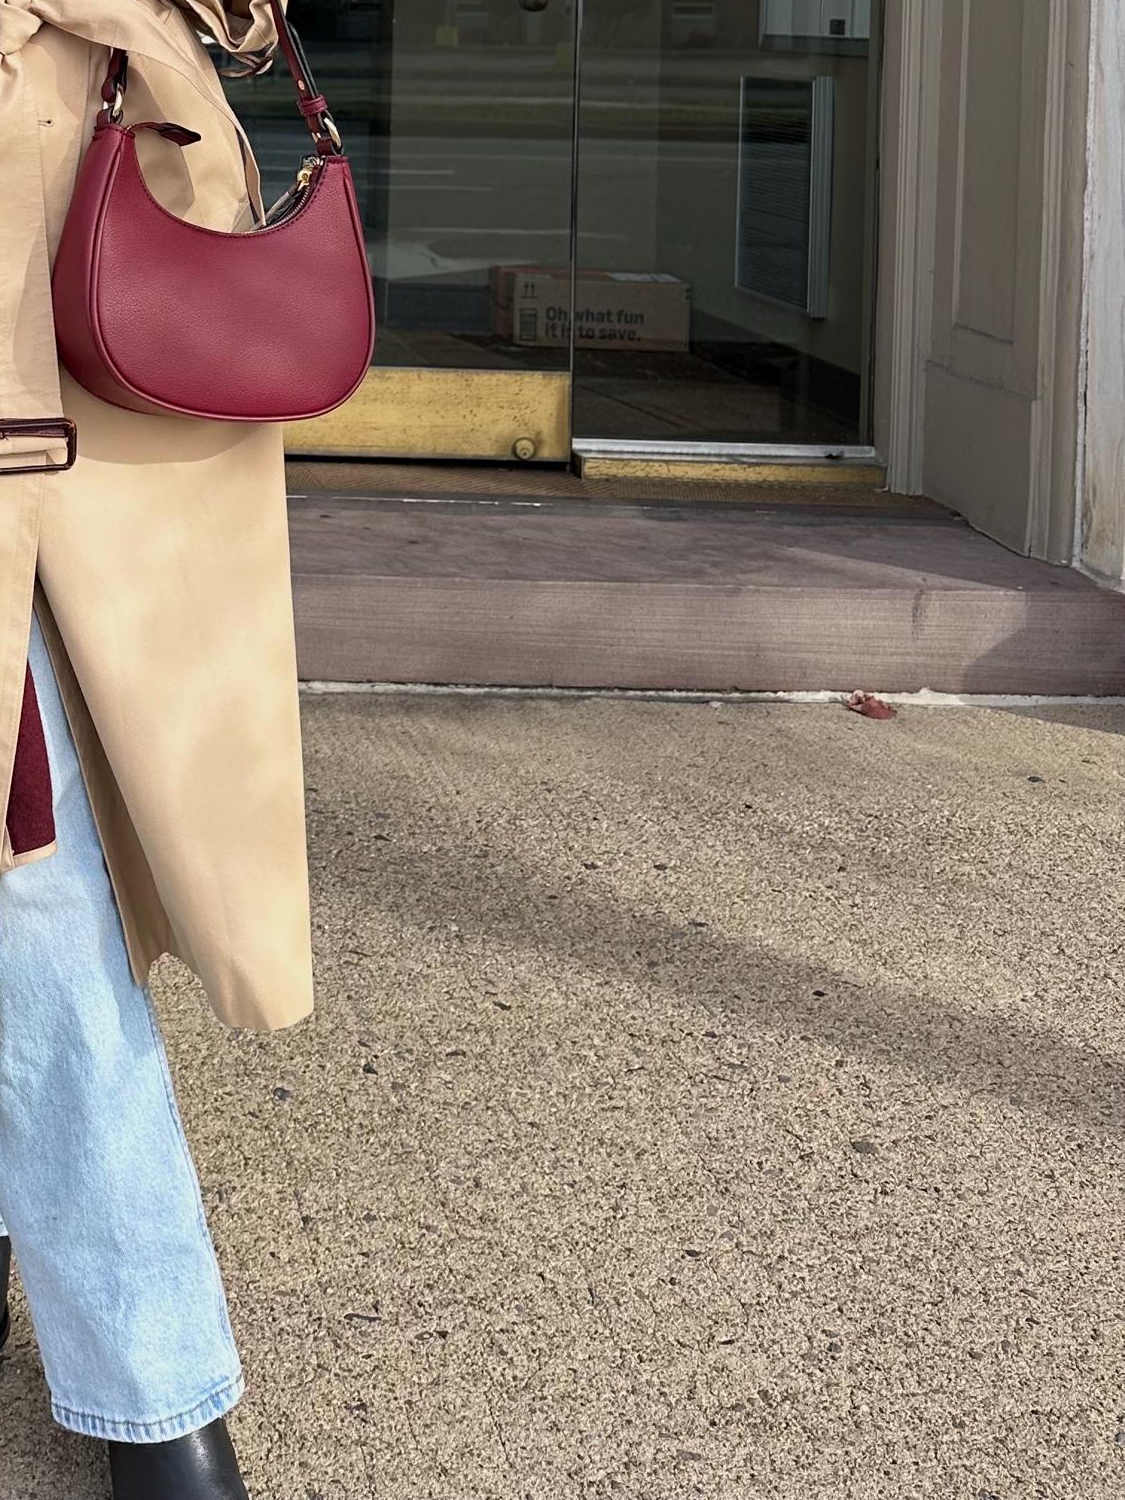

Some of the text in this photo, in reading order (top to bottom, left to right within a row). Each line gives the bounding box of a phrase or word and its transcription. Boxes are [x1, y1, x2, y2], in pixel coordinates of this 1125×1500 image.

[617, 310, 644, 324] fun
[546, 324, 557, 338] it
[578, 324, 595, 340] to
[599, 328, 641, 341] save.
